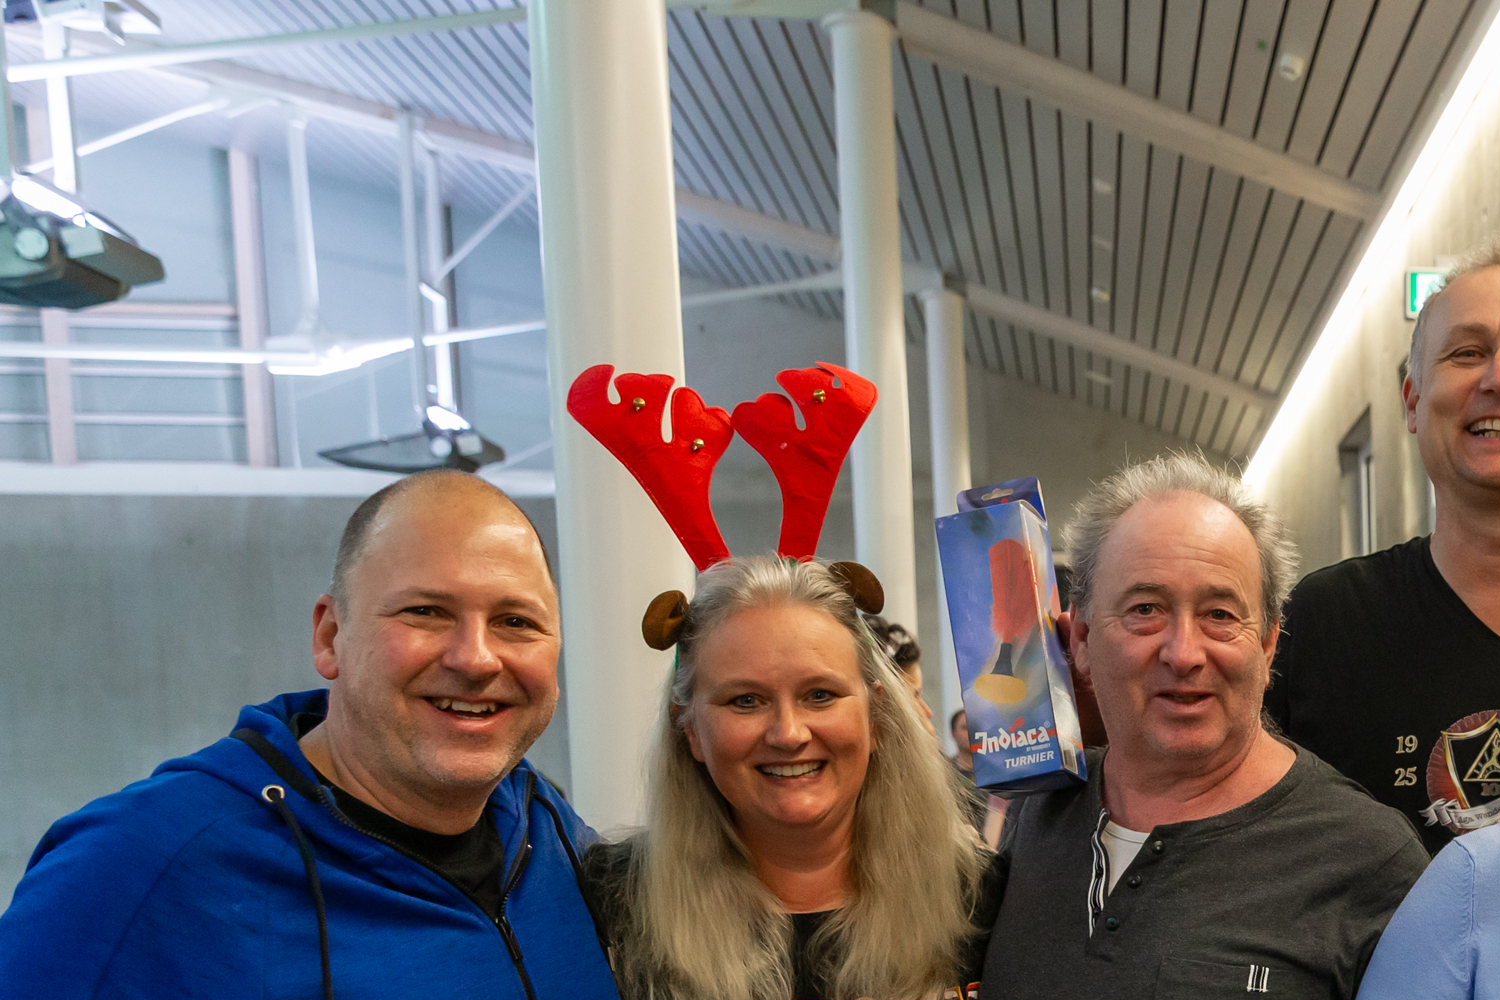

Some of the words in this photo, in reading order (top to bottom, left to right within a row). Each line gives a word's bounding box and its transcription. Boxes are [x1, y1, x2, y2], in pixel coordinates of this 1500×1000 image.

[1395, 734, 1419, 754] 19
[1004, 750, 1055, 769] TURNIER
[1394, 766, 1418, 787] 25
